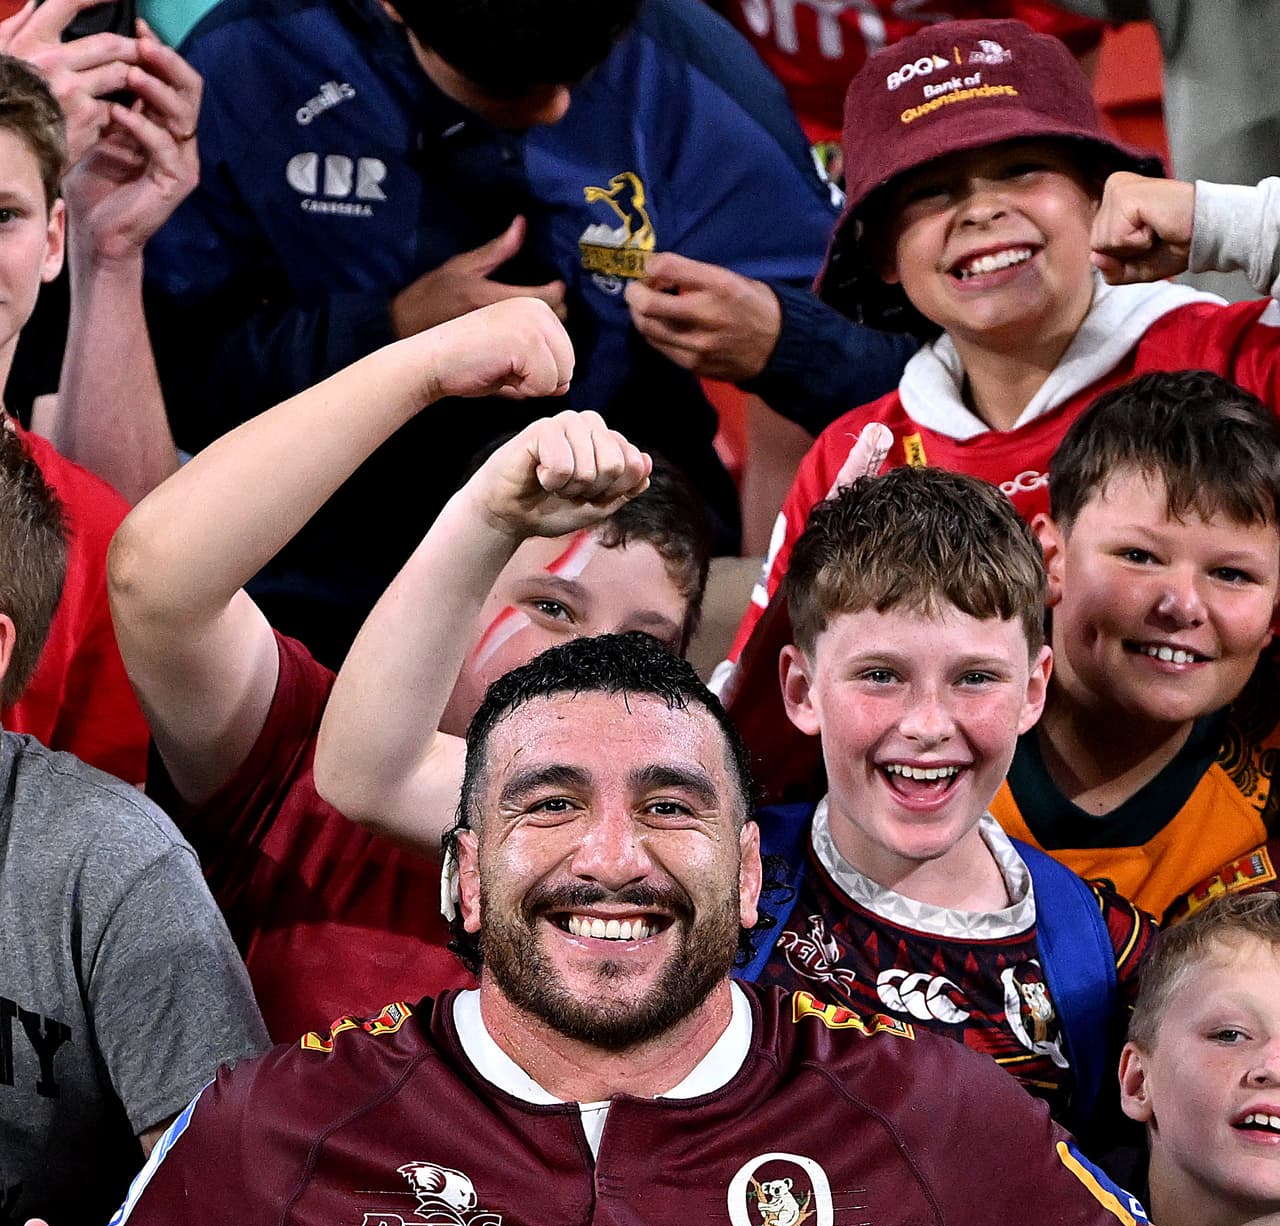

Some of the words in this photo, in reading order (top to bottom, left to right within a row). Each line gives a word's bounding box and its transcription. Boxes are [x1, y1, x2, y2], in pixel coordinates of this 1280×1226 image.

[887, 57, 934, 91] BOQ
[923, 78, 963, 99] Bank
[963, 72, 981, 87] of
[286, 152, 387, 200] CBR
